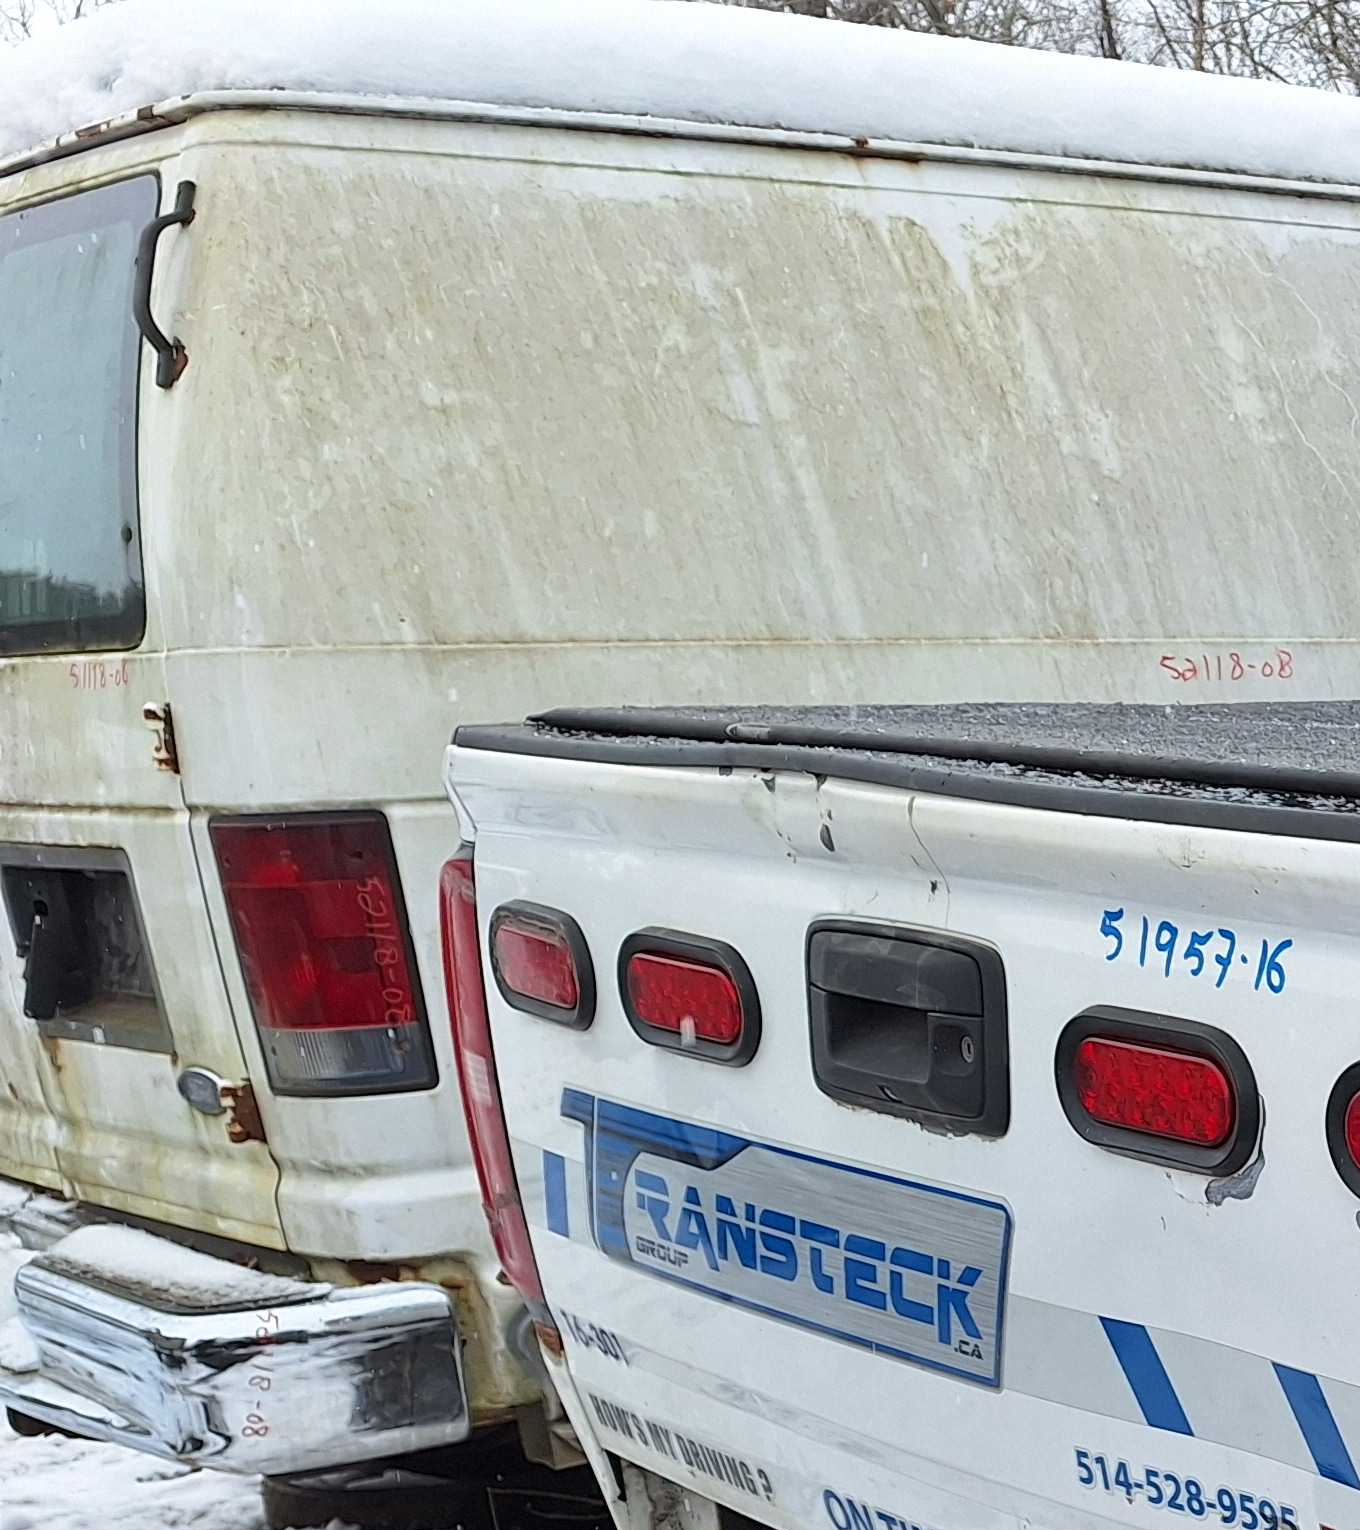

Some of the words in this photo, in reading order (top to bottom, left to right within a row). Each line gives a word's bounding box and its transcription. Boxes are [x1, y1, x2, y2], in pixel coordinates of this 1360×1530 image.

[559, 1087, 984, 1346] TRANSTECK
[635, 1236, 690, 1269] GROUP
[645, 1419, 678, 1460] MY
[675, 1433, 758, 1496] DRIVING
